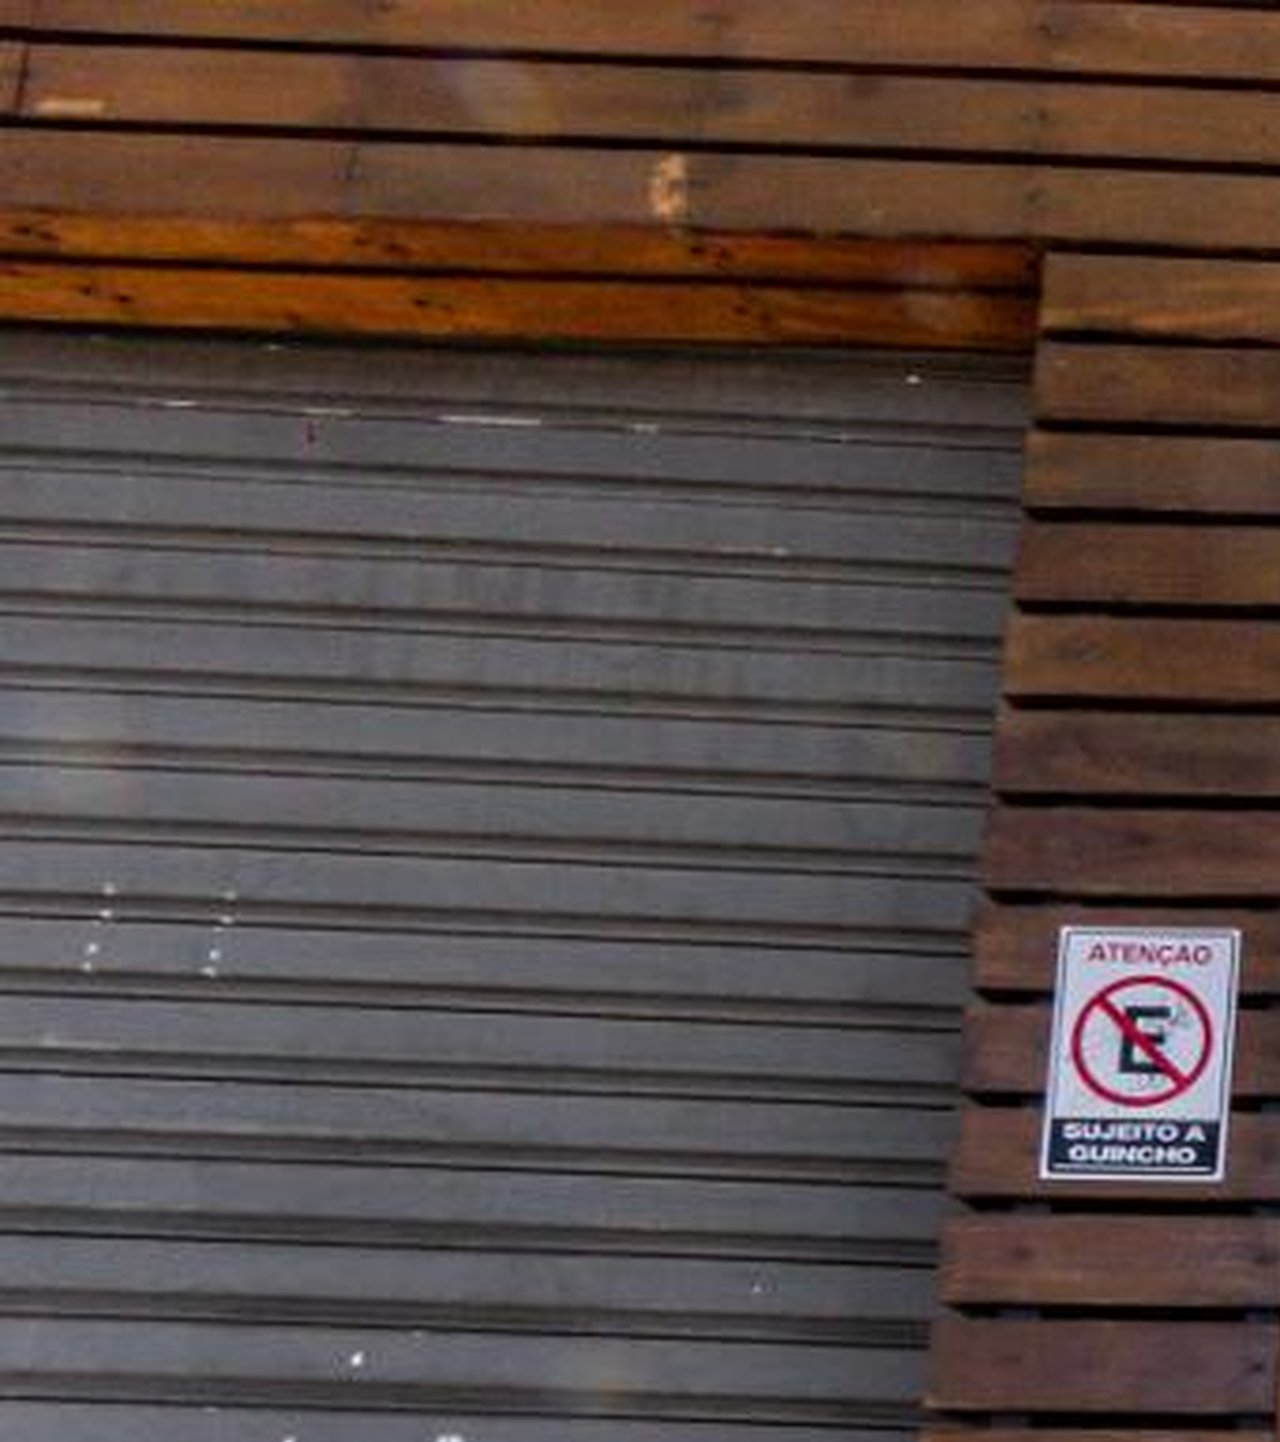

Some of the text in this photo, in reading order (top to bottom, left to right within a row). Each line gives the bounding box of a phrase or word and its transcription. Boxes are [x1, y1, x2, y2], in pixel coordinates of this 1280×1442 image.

[1062, 1122, 1207, 1143] SUJEITO A
[1067, 1144, 1197, 1165] GUINCHO
